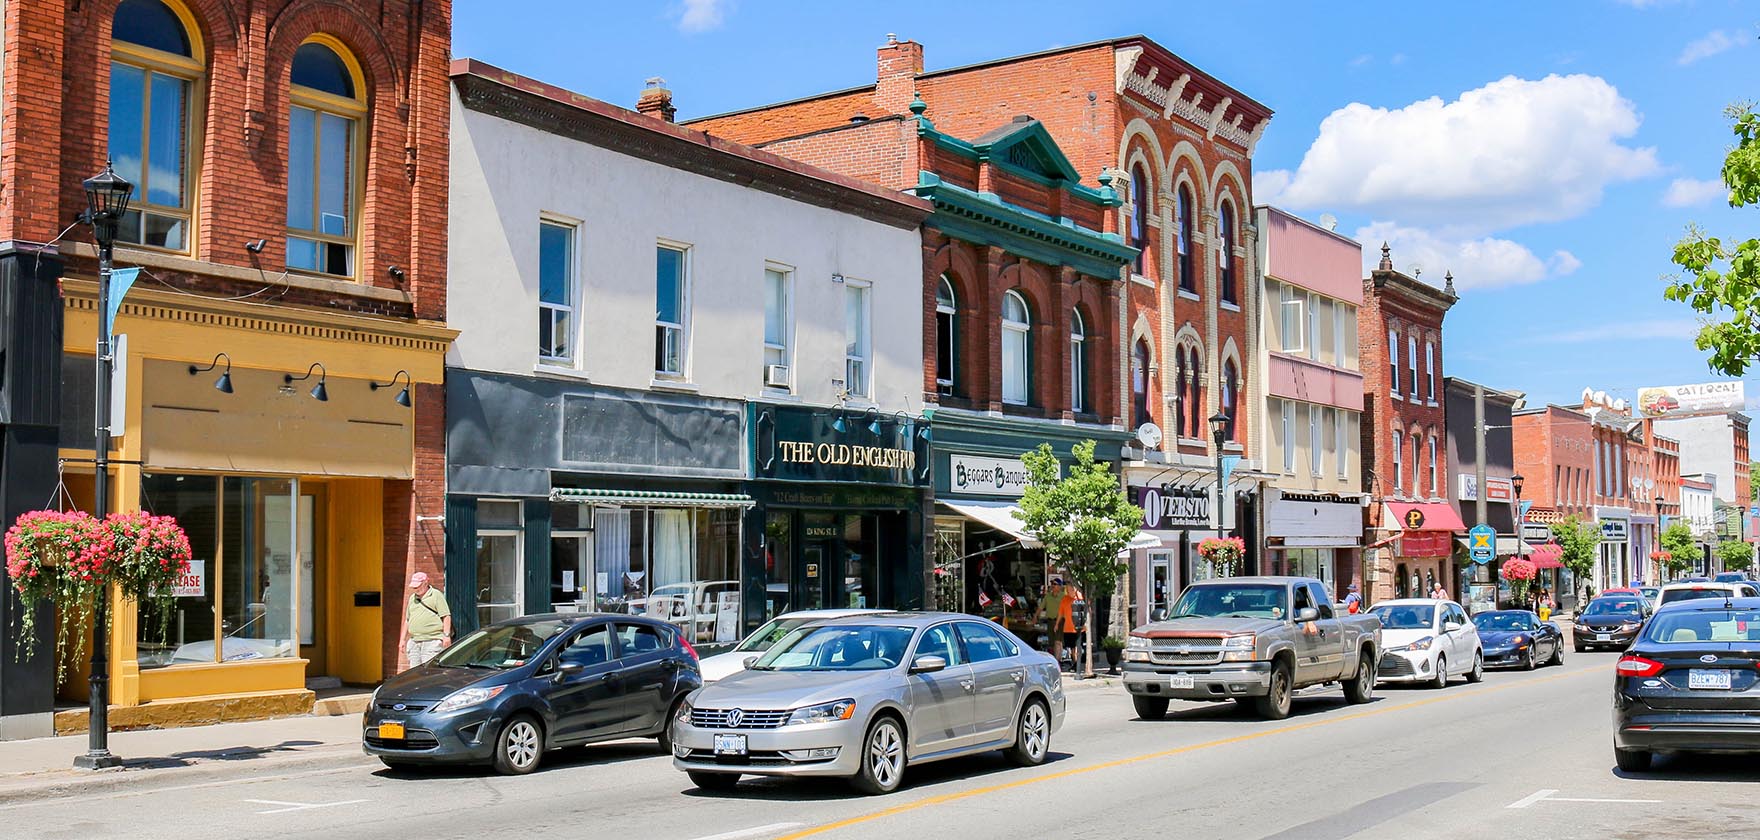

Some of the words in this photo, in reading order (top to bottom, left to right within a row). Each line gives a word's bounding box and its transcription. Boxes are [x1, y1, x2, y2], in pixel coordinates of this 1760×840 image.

[779, 441, 814, 463] THE
[817, 443, 850, 465] OLD
[852, 445, 899, 469] ENGLISH
[900, 449, 916, 470] PUB
[1144, 489, 1210, 528] OVERSTO
[1409, 511, 1422, 527] P
[176, 575, 200, 587] EASE
